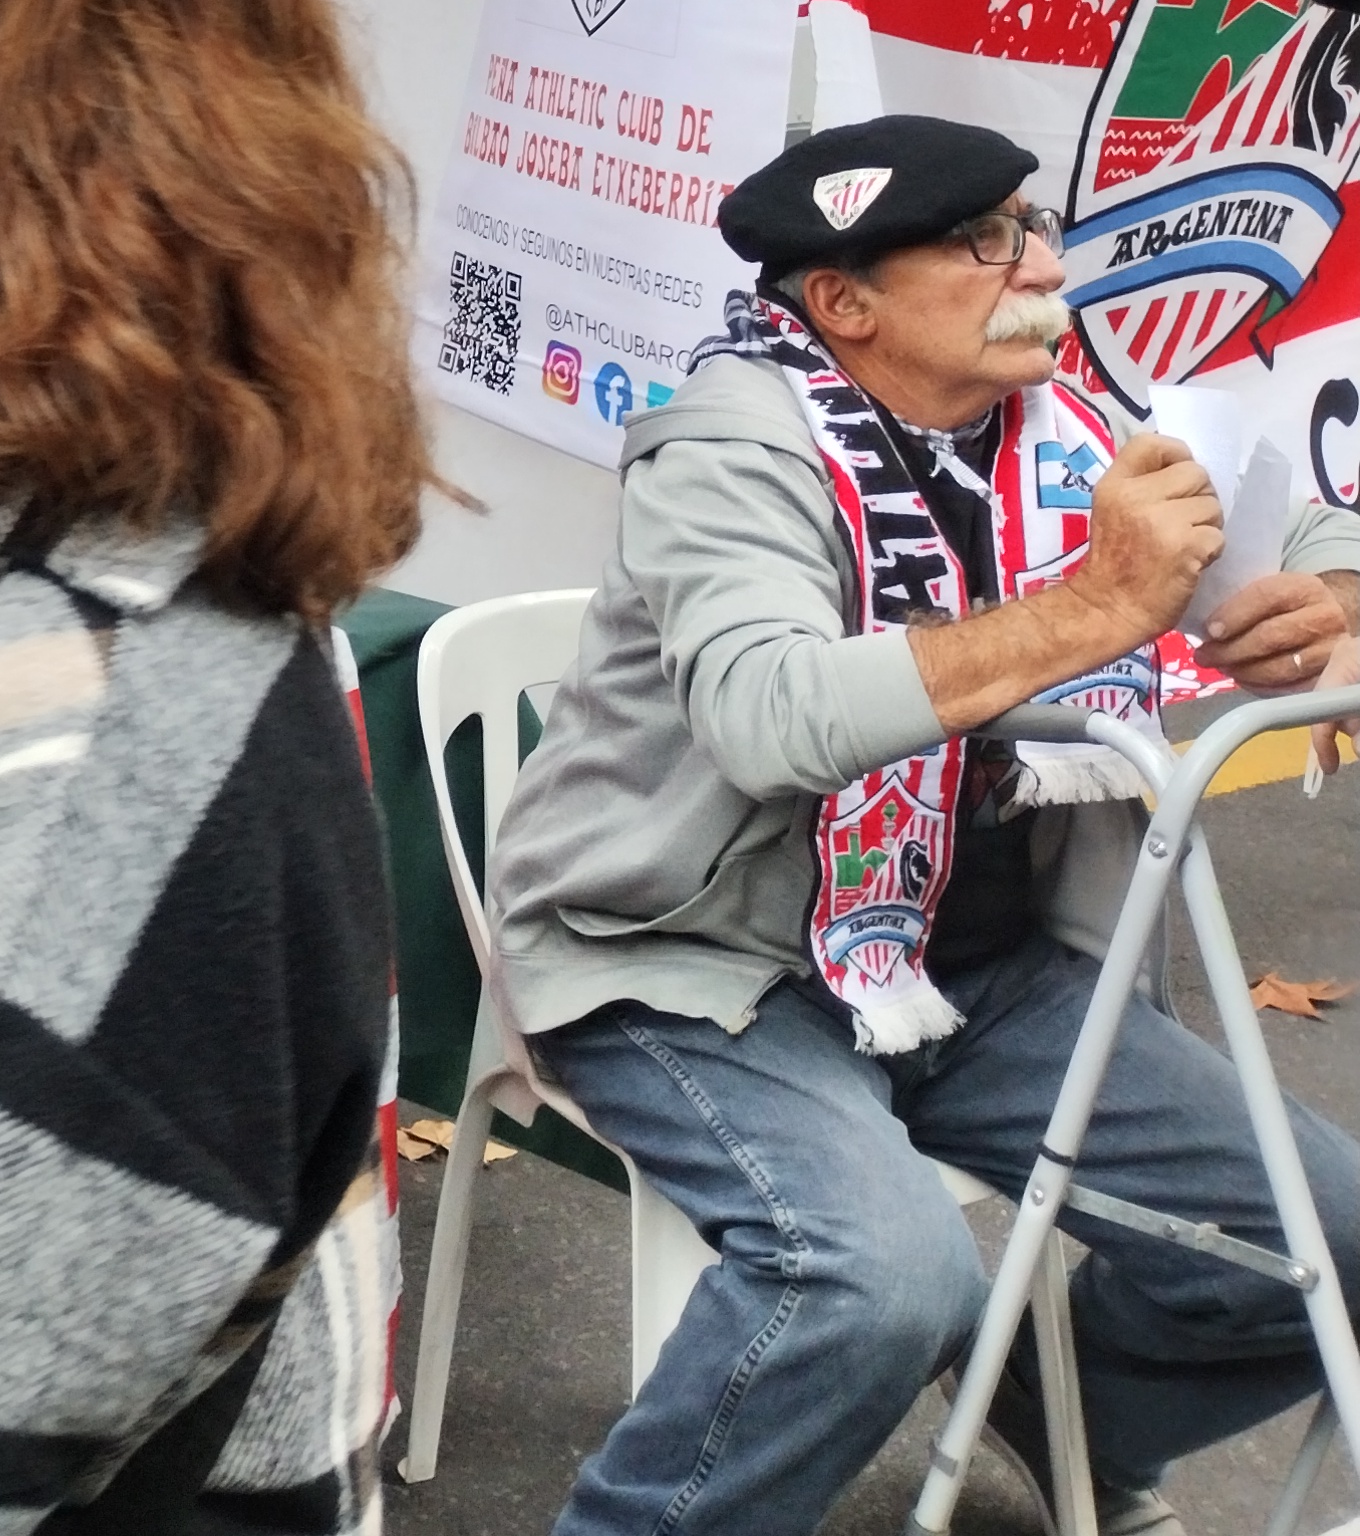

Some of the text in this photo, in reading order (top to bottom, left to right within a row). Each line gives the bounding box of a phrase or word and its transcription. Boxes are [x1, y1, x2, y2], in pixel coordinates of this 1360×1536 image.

[464, 111, 510, 168] BILBAO
[517, 130, 583, 192] JOSEBA
[524, 66, 607, 130] ATHLETIC
[617, 90, 664, 146] CLUB
[676, 104, 714, 156] DE
[520, 229, 573, 268] SEGUINOS
[575, 247, 589, 275] EN
[590, 252, 651, 296] NUESTRAS
[653, 272, 703, 310] REDES
[1106, 198, 1294, 269] ARGENTINA
